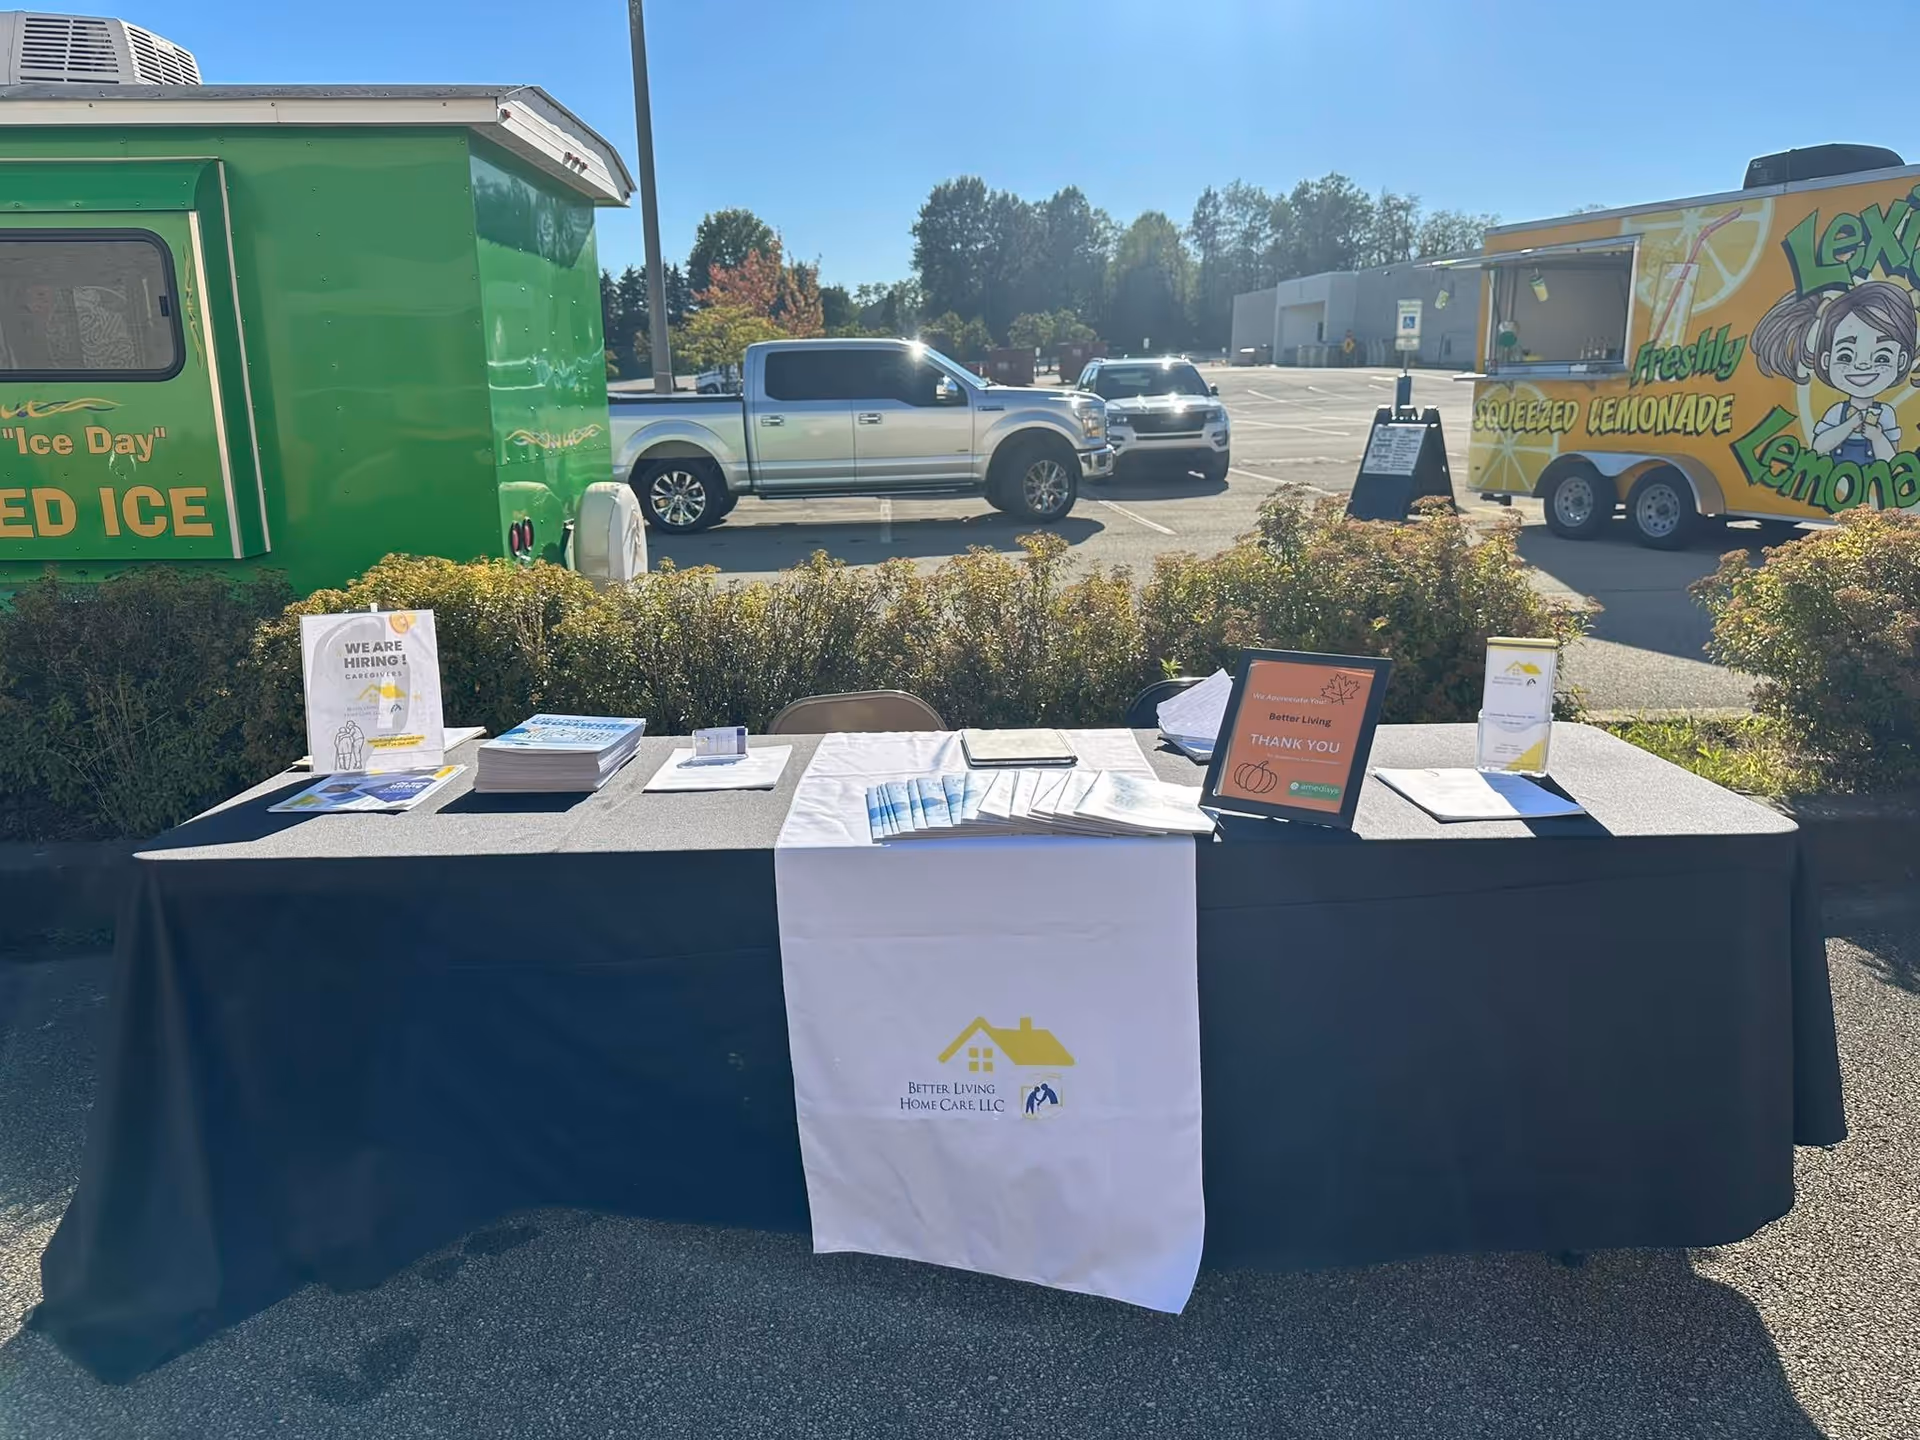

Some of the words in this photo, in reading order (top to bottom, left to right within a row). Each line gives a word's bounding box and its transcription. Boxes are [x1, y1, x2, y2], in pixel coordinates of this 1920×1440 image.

[1629, 323, 1748, 388] Freshly
[1473, 397, 1580, 435] SQUEEZED
[1586, 392, 1736, 436] LEMONADE
[98, 485, 214, 538] ICE
[345, 642, 370, 654] WE
[373, 641, 403, 653] ARE
[345, 671, 402, 679] CAREGIVERS
[1269, 712, 1300, 723] Better
[1302, 716, 1332, 728] Living
[1250, 733, 1302, 750] THANK
[1307, 740, 1341, 753] YOU
[979, 1099, 1004, 1112] LLC
